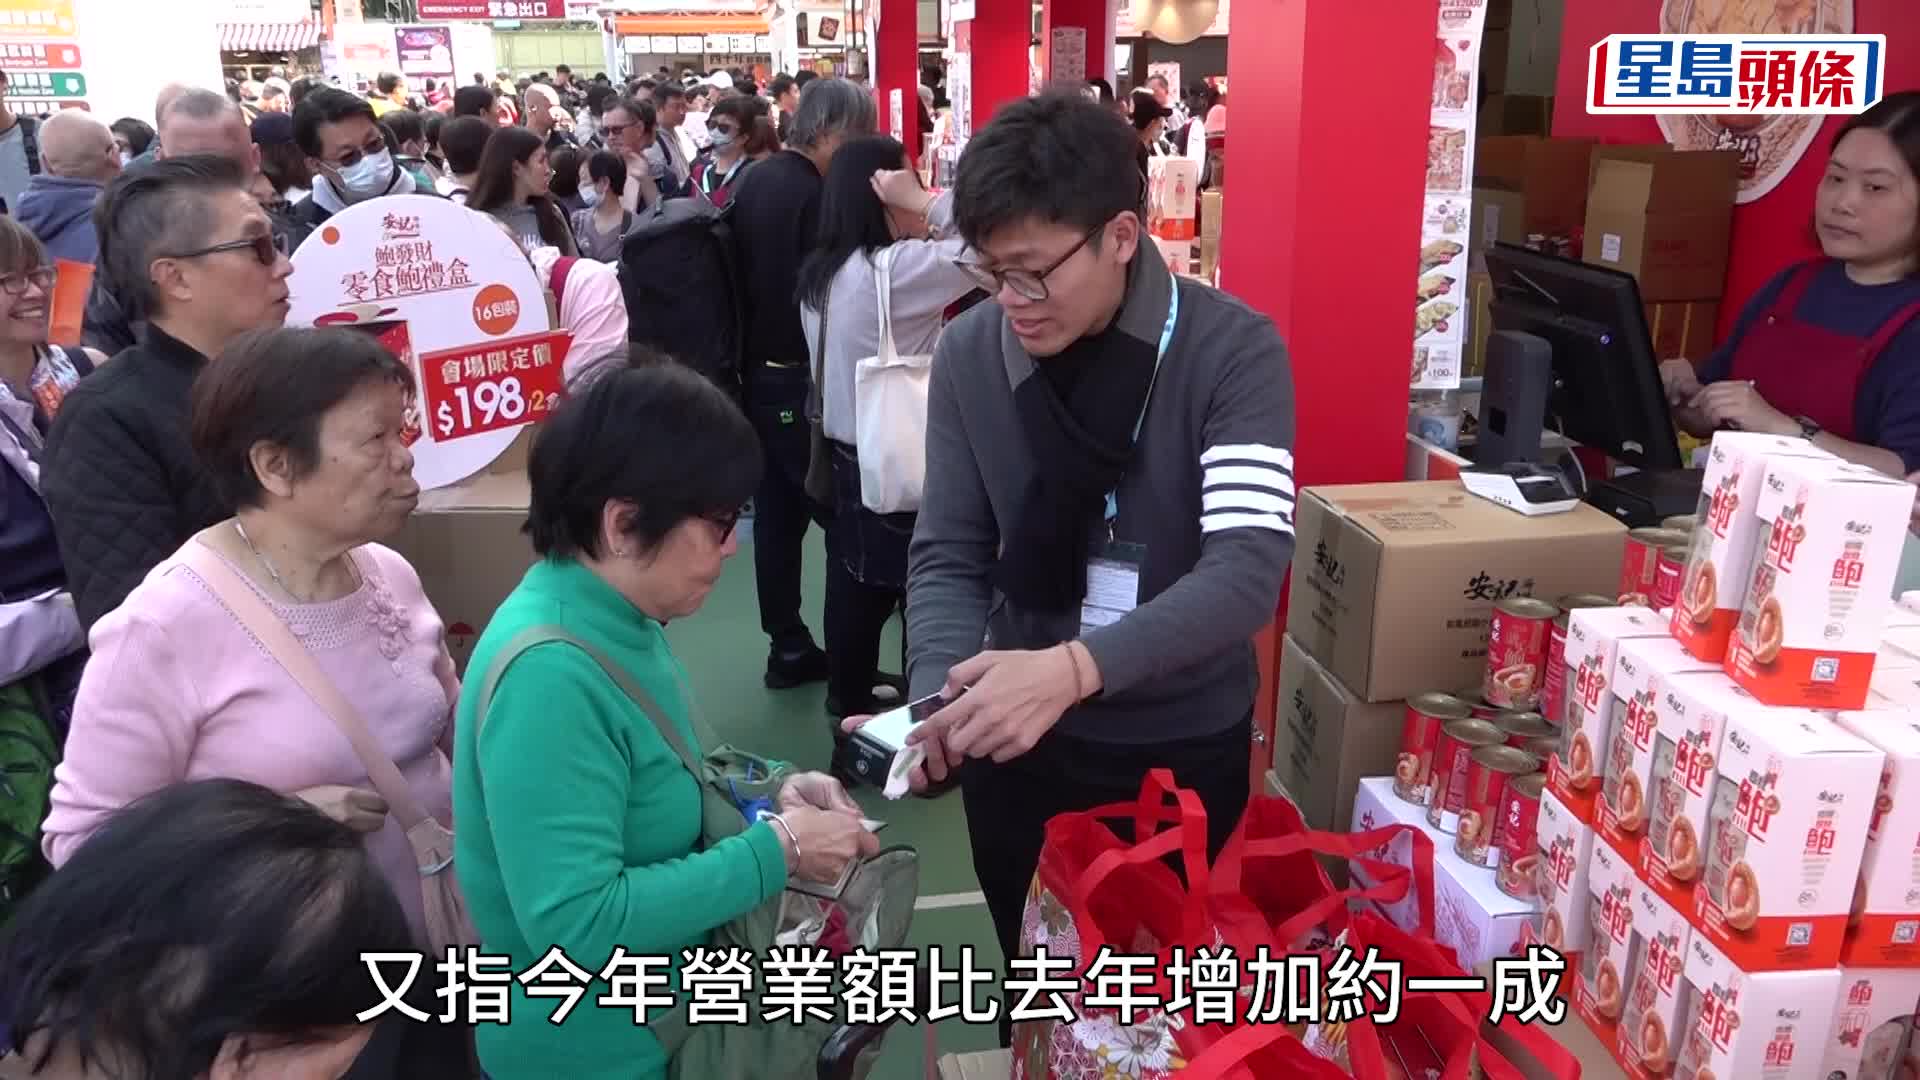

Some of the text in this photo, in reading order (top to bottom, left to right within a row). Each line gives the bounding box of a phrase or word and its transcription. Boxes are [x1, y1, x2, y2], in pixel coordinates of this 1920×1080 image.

[488, 2, 548, 17] 緊急出口
[375, 240, 432, 267] 鮑發財
[341, 258, 473, 300] 零食鮑禮盒
[475, 300, 518, 321] 16包裝
[441, 342, 552, 385] 會場限定價
